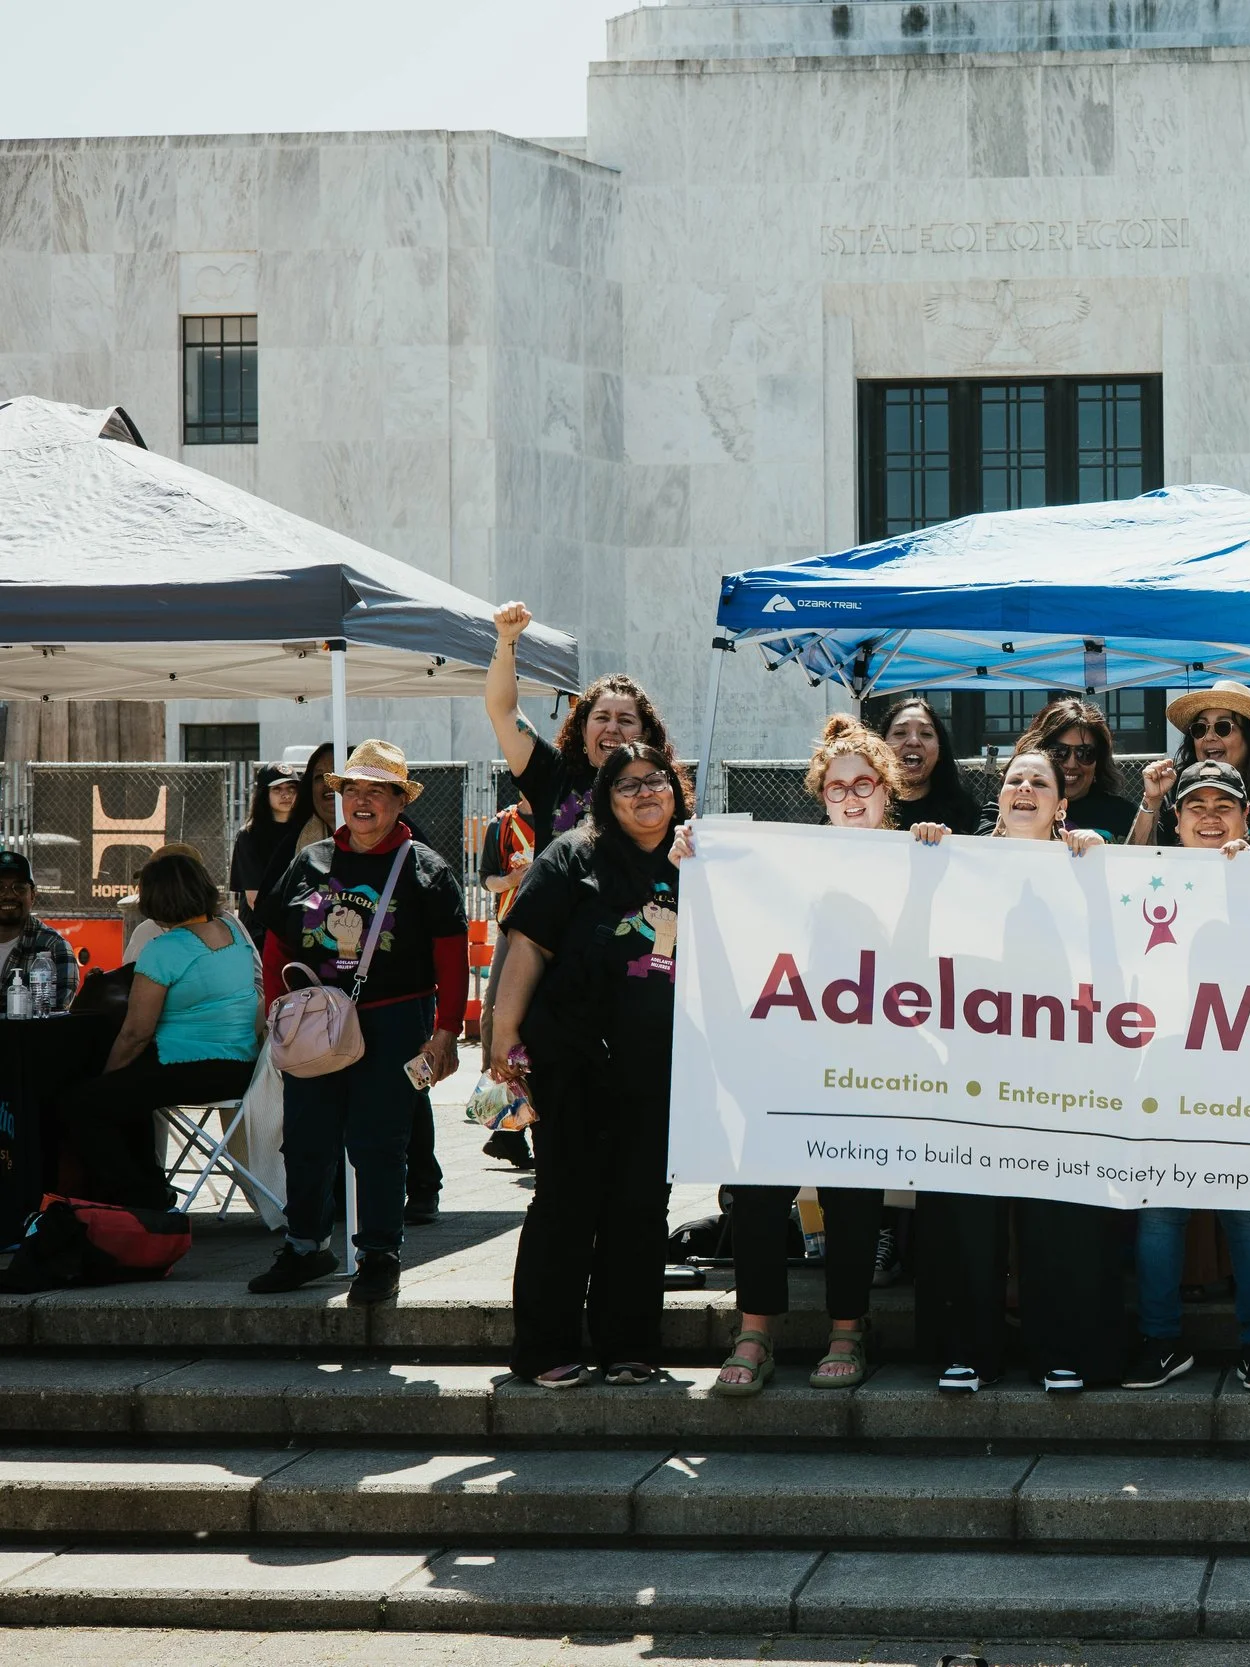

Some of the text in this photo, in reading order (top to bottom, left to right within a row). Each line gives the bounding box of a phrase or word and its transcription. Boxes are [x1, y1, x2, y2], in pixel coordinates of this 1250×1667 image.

[820, 218, 1190, 255] STATE OF OREGON
[650, 957, 673, 967] ADELANTE
[650, 962, 671, 971] MUJERES
[749, 950, 1157, 1049] Adelante
[824, 1068, 948, 1094] Education
[998, 1081, 1123, 1113] Enterprise
[806, 1140, 889, 1167] Working
[897, 1144, 917, 1162] to
[924, 1143, 972, 1167] build
[979, 1154, 991, 1168] a
[999, 1155, 1050, 1171] more
[1054, 1157, 1090, 1178] just
[1097, 1163, 1166, 1186] society
[1173, 1164, 1197, 1189] by
